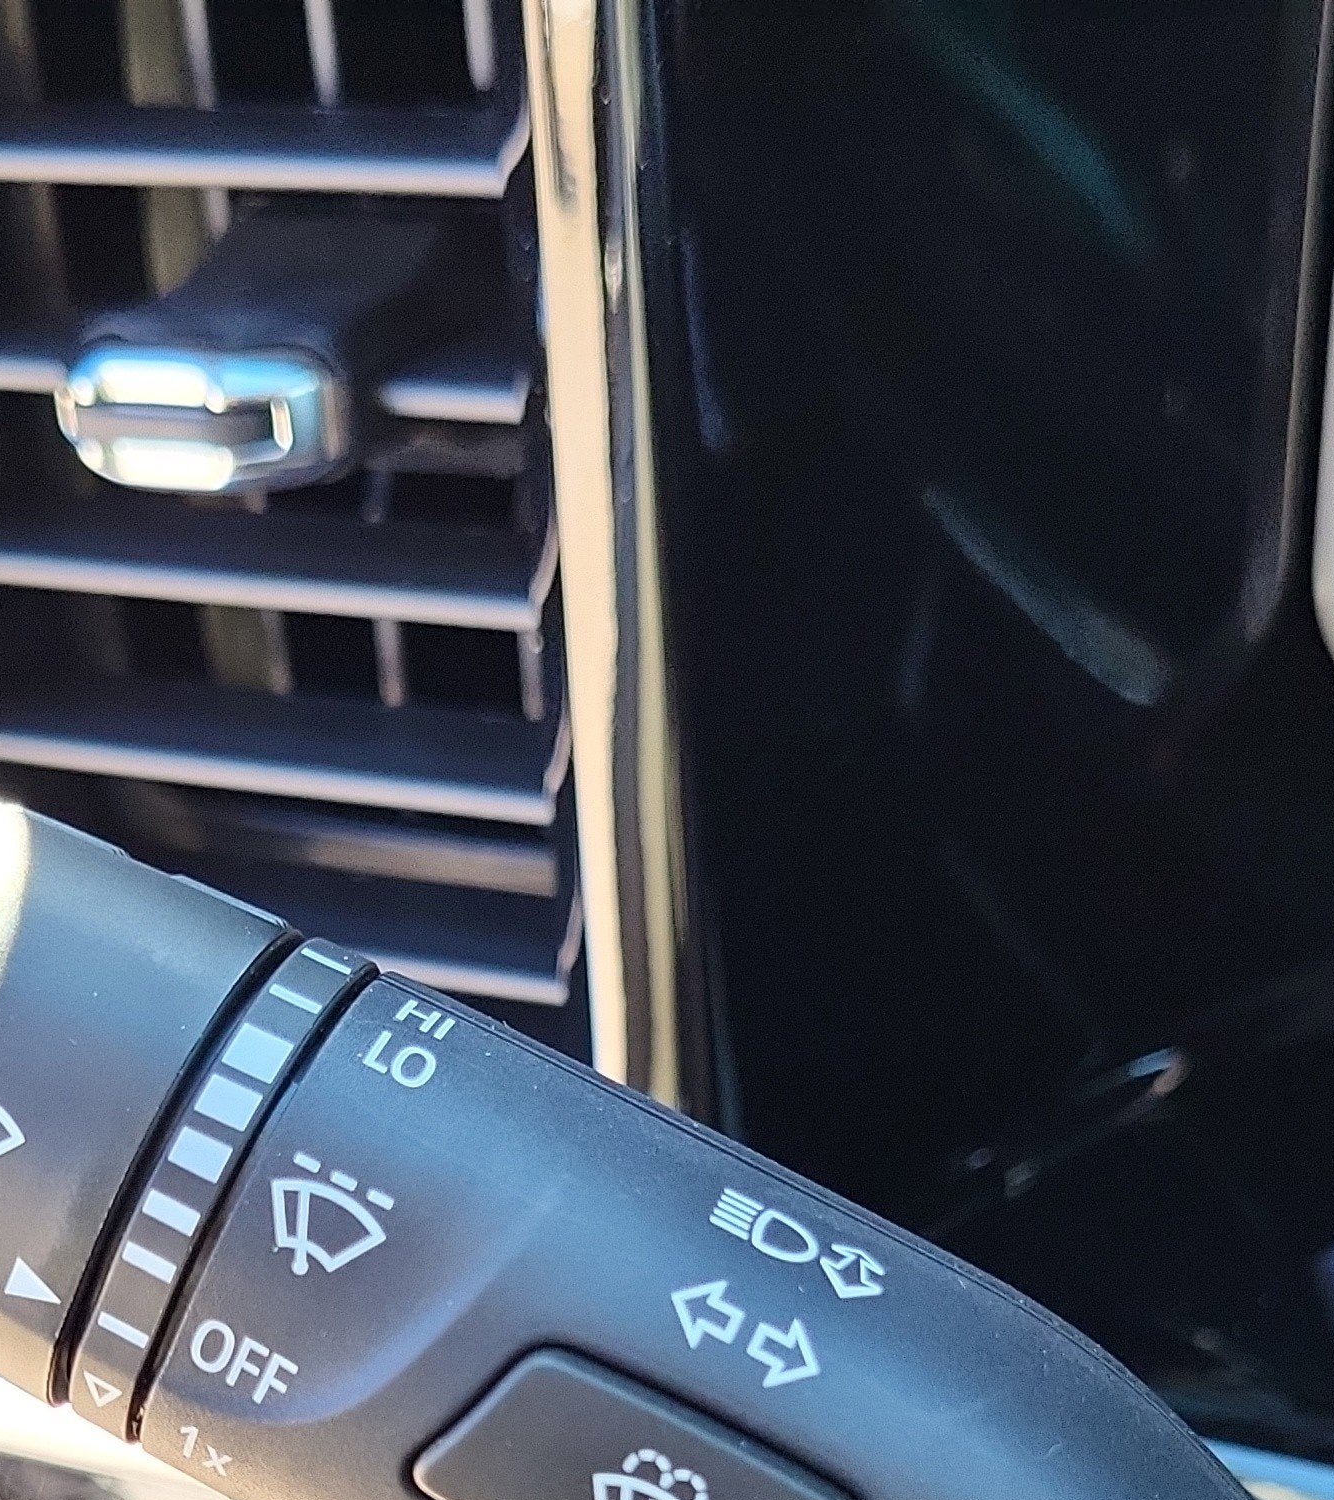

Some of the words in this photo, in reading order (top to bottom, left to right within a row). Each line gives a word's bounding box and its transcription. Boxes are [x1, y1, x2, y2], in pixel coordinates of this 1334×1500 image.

[395, 998, 455, 1042] HI
[363, 1029, 438, 1089] LO
[189, 1318, 299, 1405] OFF
